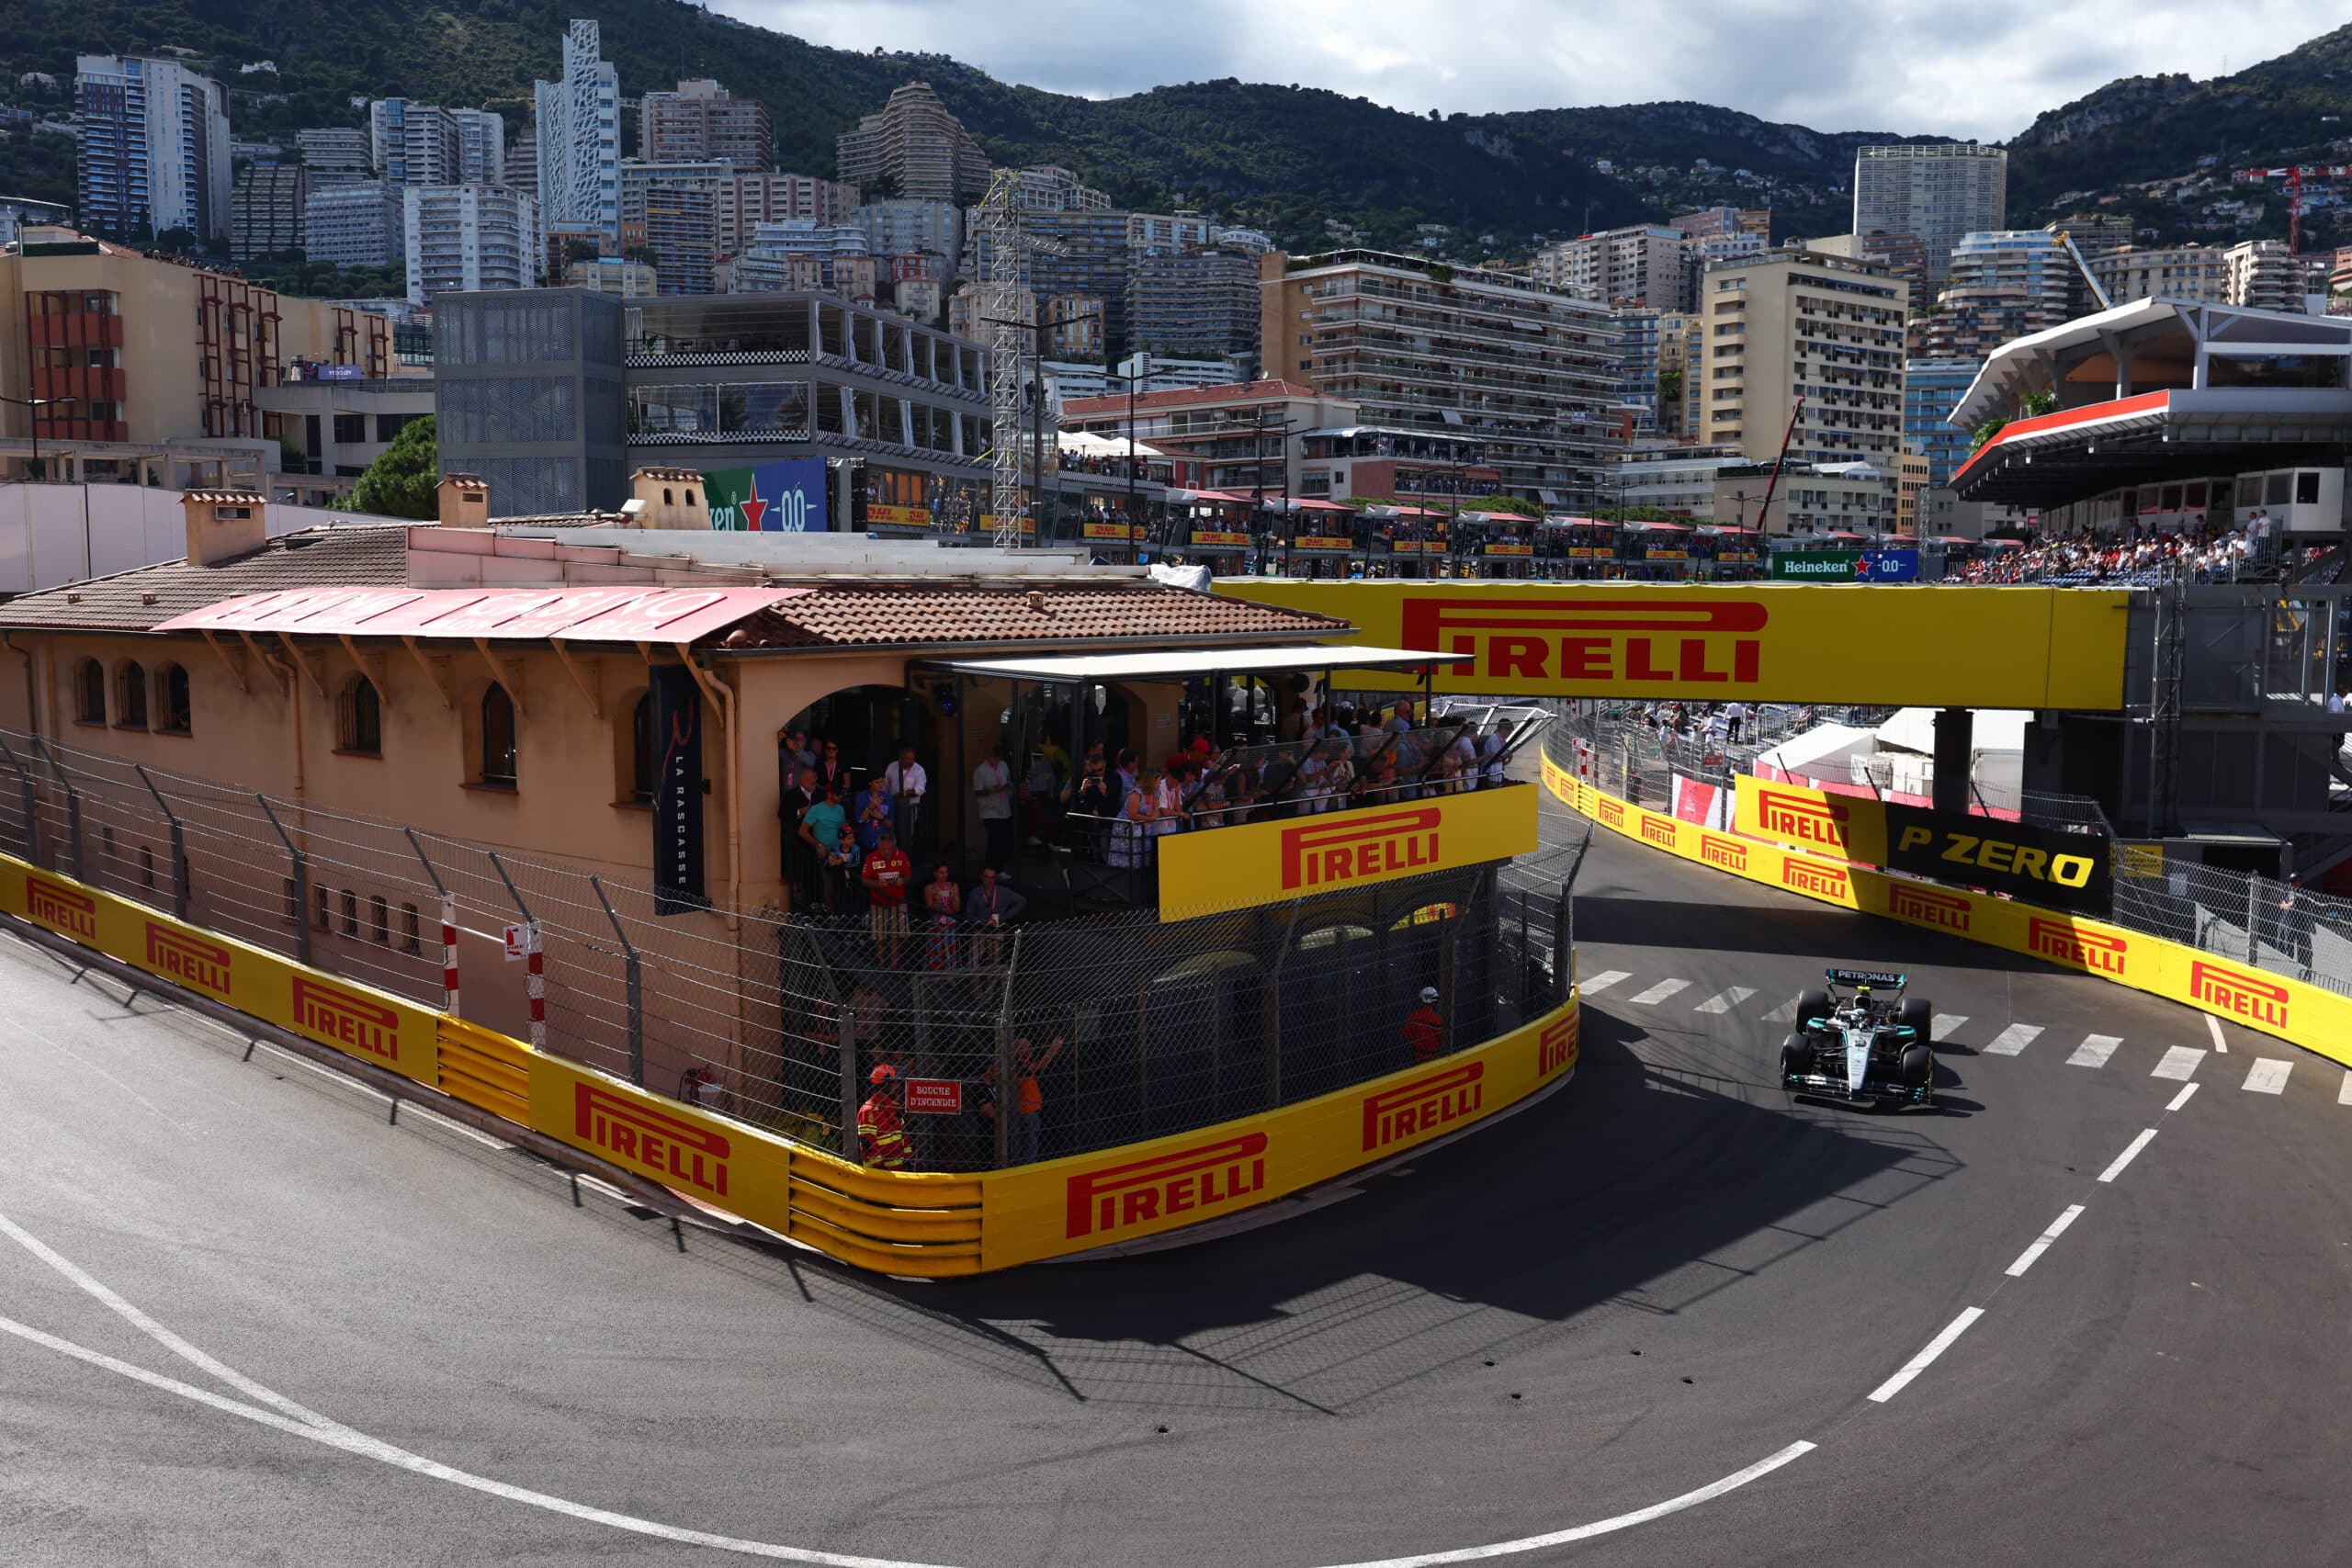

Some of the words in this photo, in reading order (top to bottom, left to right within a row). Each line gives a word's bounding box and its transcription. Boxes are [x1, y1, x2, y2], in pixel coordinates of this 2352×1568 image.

[1784, 559, 1849, 573] Heineken
[1403, 598, 1769, 682] PIRELLI
[675, 756, 684, 777] LA
[676, 786, 686, 885] RASCASSE
[1599, 797, 1624, 828] PIRELLI
[1641, 814, 1676, 849] PIRELLI
[1758, 789, 1849, 849] PIRELLI
[1282, 807, 1440, 890] PIRELLI
[1701, 834, 1747, 872] PIRELLI
[1782, 856, 1847, 899] PIRELLI
[1898, 826, 1932, 852] P
[1940, 832, 2094, 889] ZERO
[27, 876, 96, 940] PIRELLI
[1889, 882, 1971, 929] PIRELLI
[146, 921, 231, 994] PIRELLI
[1838, 970, 1895, 982] PETRONAS
[2029, 916, 2128, 975] PIRELLI
[292, 976, 399, 1062] PIRELLI
[2190, 960, 2289, 1029] PIRELLI
[916, 1086, 951, 1095] BOUCHE
[1363, 1061, 1485, 1152] PIRELLI
[575, 1081, 729, 1198] PIRELLI
[1067, 1133, 1267, 1240] PIRELLI
